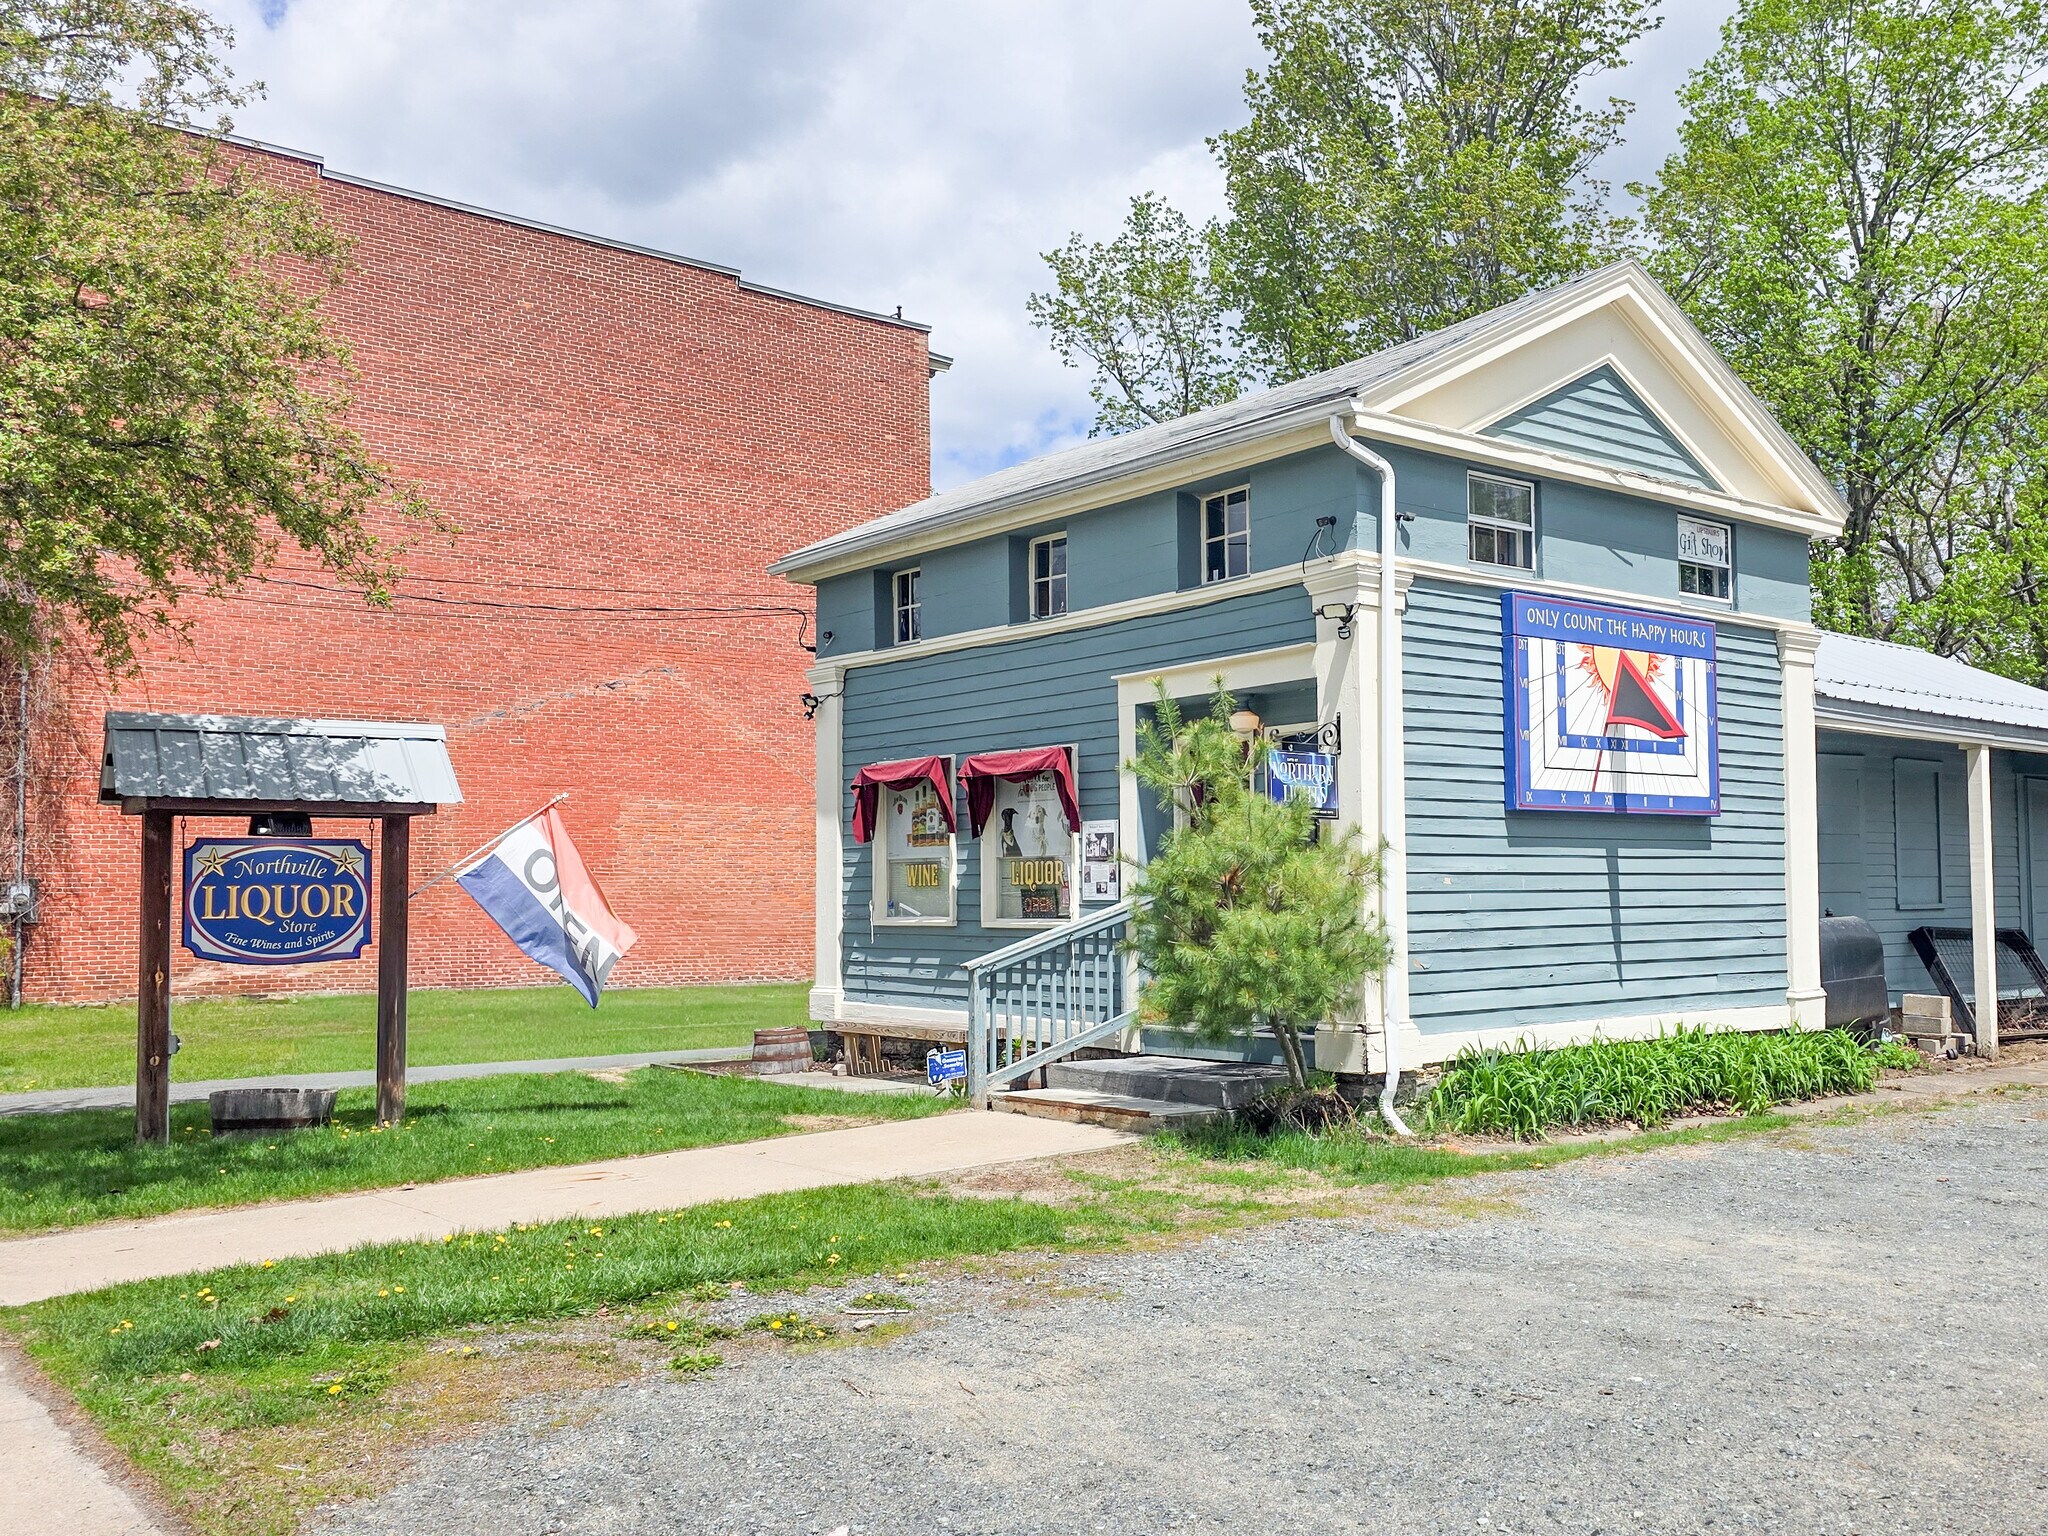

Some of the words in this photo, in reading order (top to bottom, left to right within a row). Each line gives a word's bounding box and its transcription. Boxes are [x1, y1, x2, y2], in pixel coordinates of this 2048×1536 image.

[1680, 531, 1698, 556] Gift
[1701, 537, 1724, 561] Shop
[1526, 607, 1560, 629] ONLY
[1563, 612, 1604, 634] COUNT
[1606, 619, 1628, 638] THE
[1631, 622, 1667, 643] HAPPY
[1670, 628, 1706, 649] HOURS
[1519, 638, 1528, 651] DST
[1556, 642, 1565, 655] EST
[1557, 663, 1565, 676] VI
[1708, 716, 1715, 726] V
[1580, 736, 1589, 748] IX
[1595, 738, 1602, 749] X
[1271, 761, 1334, 786] NORTHERN
[1525, 791, 1533, 802] IX
[1561, 792, 1567, 804] X
[1583, 793, 1591, 805] XI
[1604, 794, 1613, 806] XII
[1710, 799, 1718, 810] IV
[233, 854, 328, 879] Northville
[906, 864, 940, 888] WINE
[1011, 859, 1066, 892] LIQUOR
[201, 883, 357, 926] LIQUOR
[279, 919, 318, 934] Store
[224, 931, 249, 947] Fine
[250, 938, 282, 949] Wines
[284, 938, 303, 949] and
[305, 930, 336, 948] Spirits
